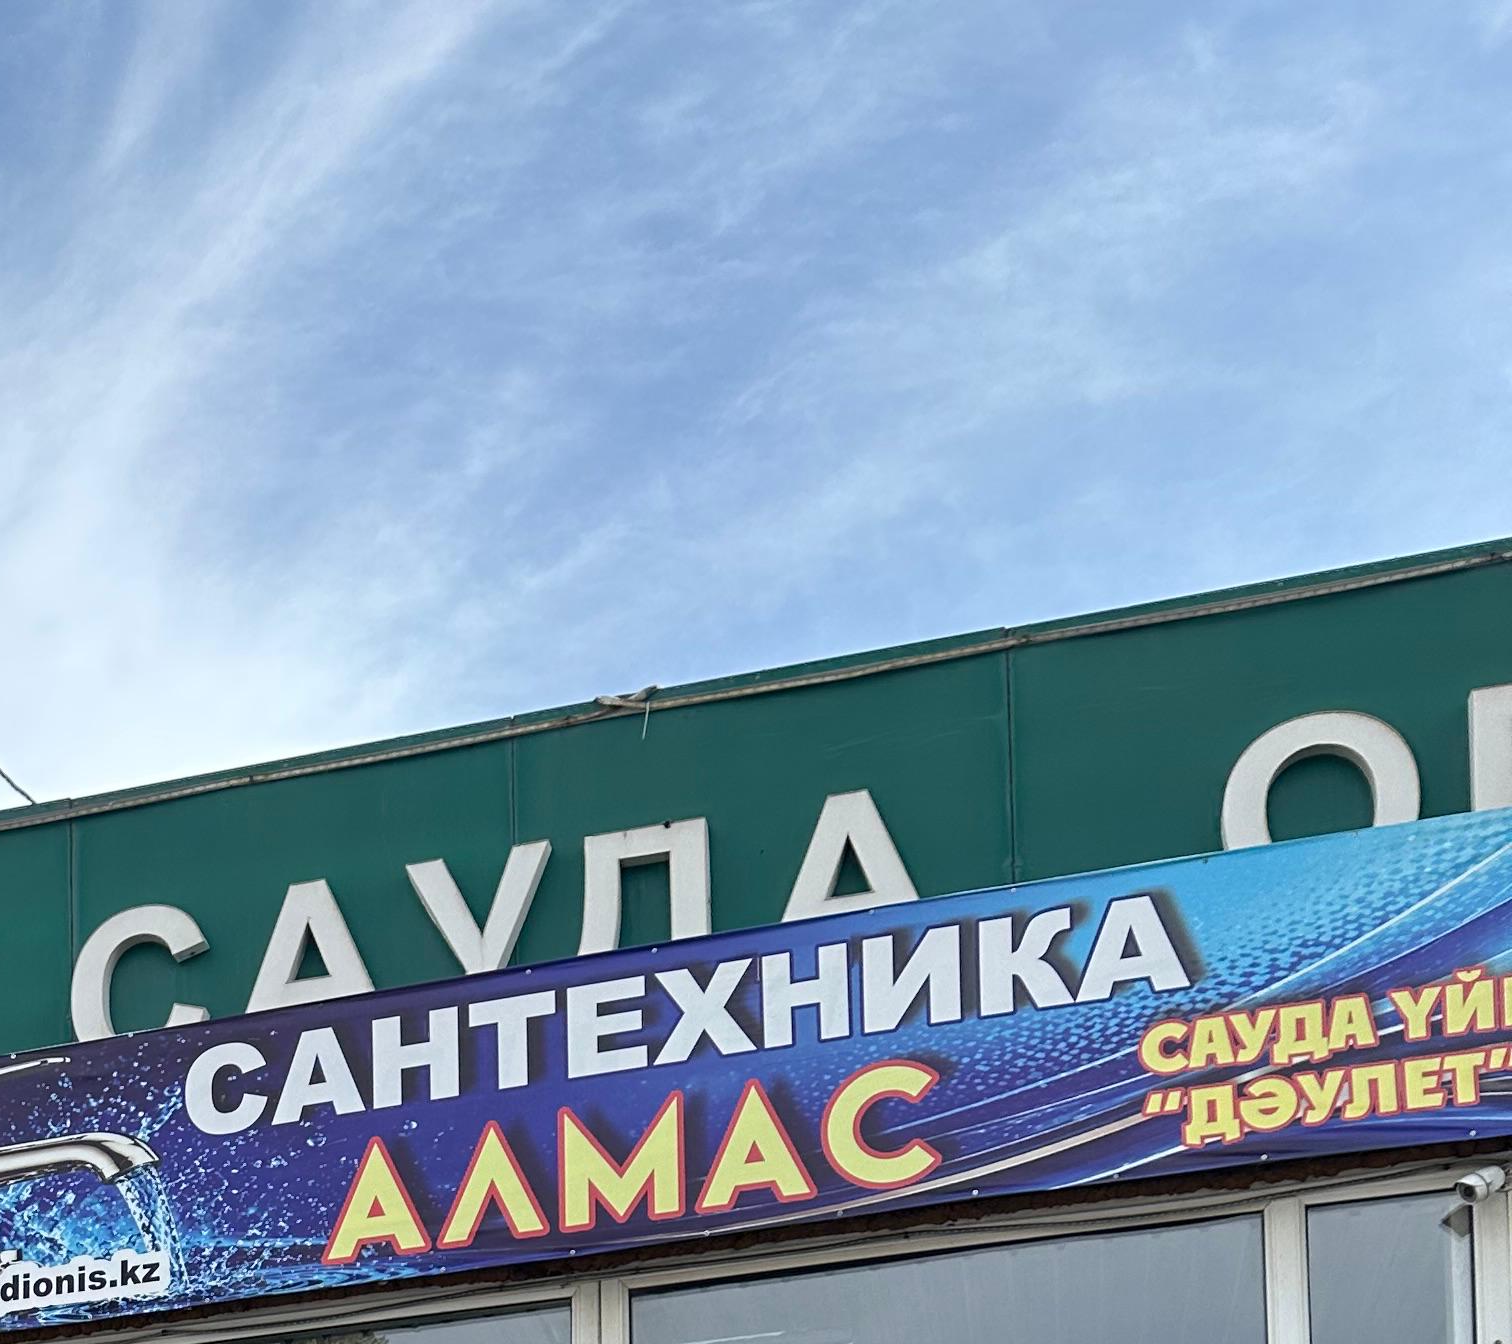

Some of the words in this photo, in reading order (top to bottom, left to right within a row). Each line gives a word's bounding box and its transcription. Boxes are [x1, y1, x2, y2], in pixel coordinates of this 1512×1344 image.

[1221, 685, 1512, 852] О
[184, 894, 1190, 1135] САНТЕХНИКА
[1139, 993, 1381, 1075] САУДА
[323, 1060, 942, 1265] АЛМАС
